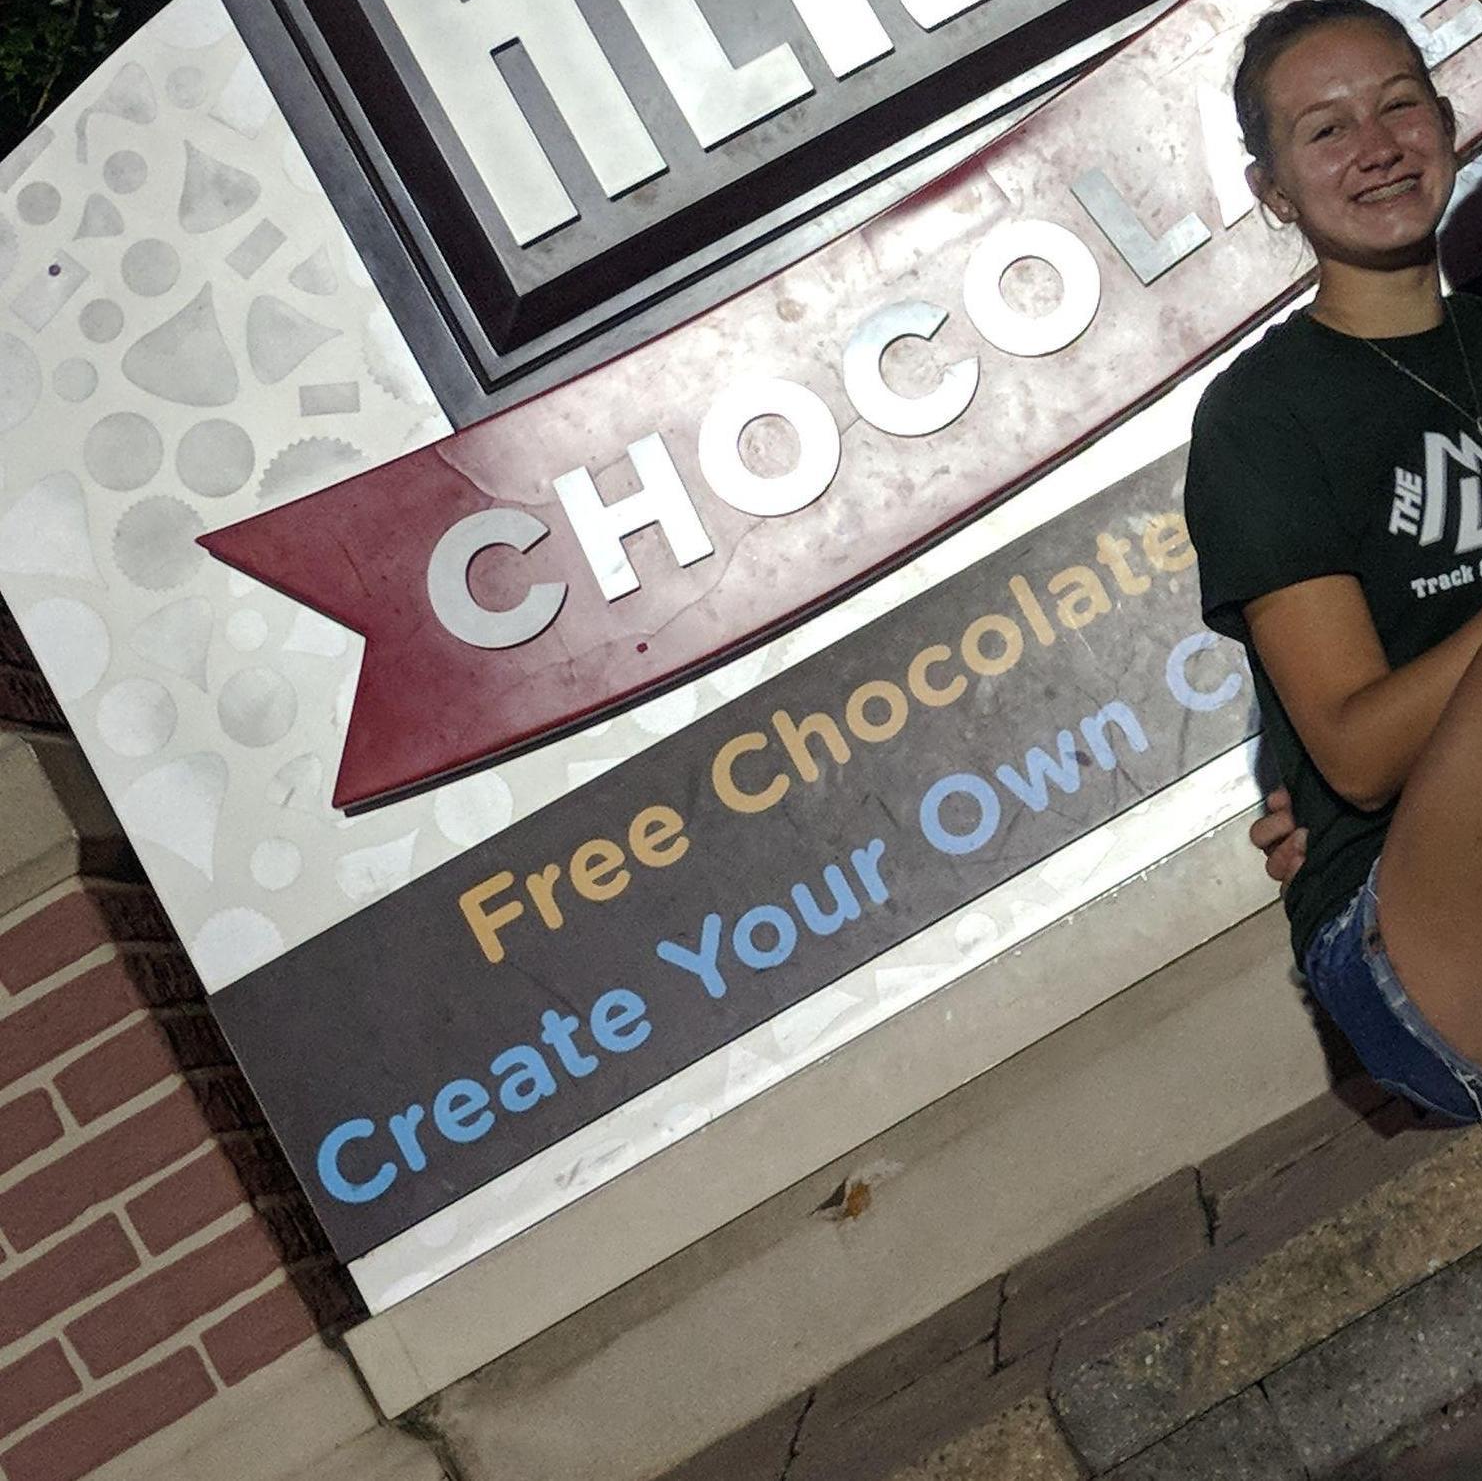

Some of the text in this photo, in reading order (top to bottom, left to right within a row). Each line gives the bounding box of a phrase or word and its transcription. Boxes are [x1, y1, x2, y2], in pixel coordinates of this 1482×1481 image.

[1388, 466, 1423, 537] THE
[1410, 564, 1475, 599] Track
[458, 512, 1198, 964] Free Chocolate
[316, 701, 1149, 1206] Create Your Own
